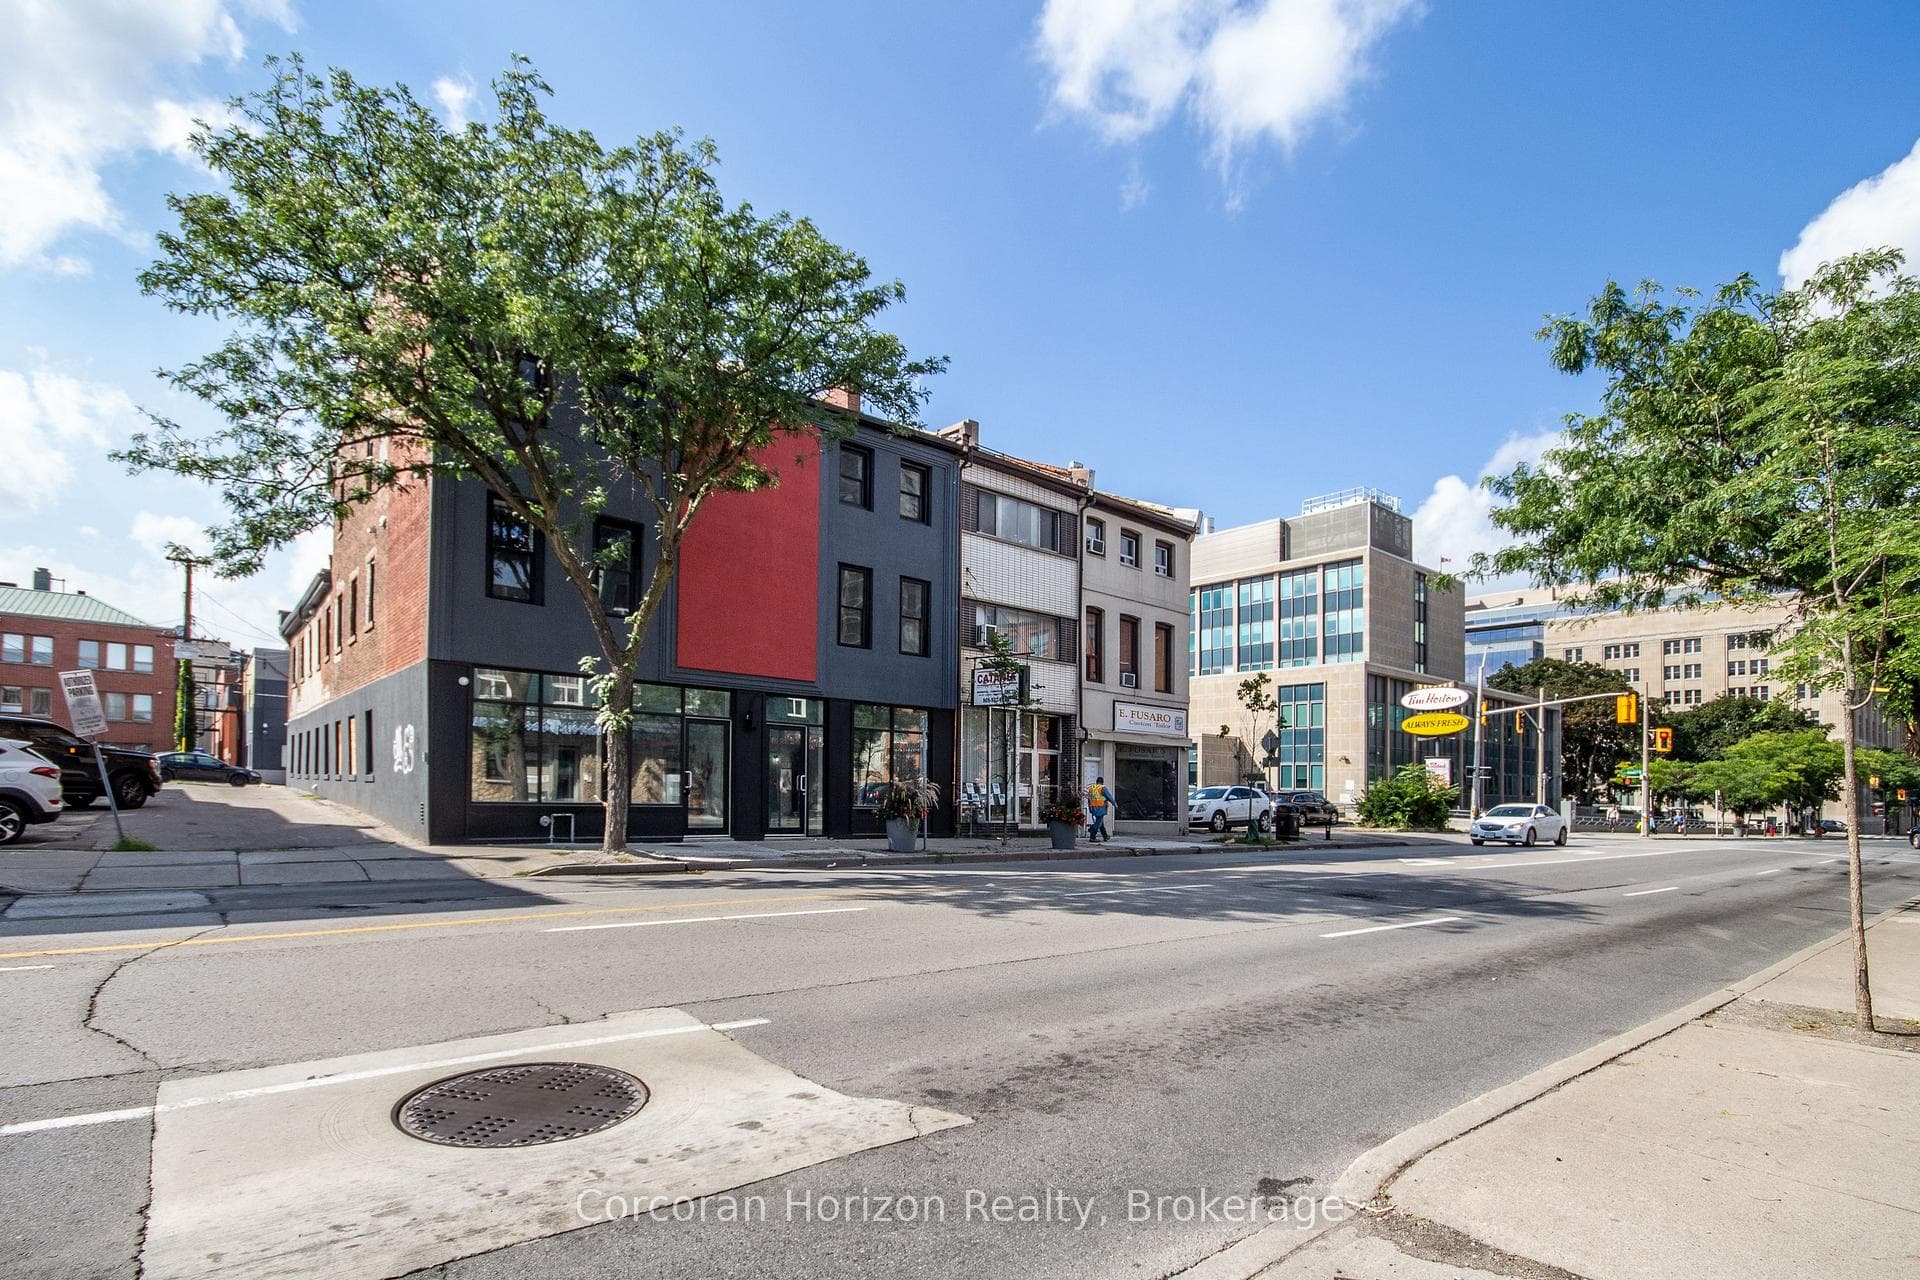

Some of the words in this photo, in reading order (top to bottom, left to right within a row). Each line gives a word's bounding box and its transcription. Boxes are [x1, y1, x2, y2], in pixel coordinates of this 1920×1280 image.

[1408, 693, 1424, 705] Tim
[1426, 692, 1462, 704] Hortons
[1119, 709, 1128, 718] E.
[1131, 710, 1171, 722] FUSARO
[1129, 719, 1152, 727] Custom
[1405, 720, 1435, 729] ALWAYS
[1436, 718, 1464, 728] FRESH
